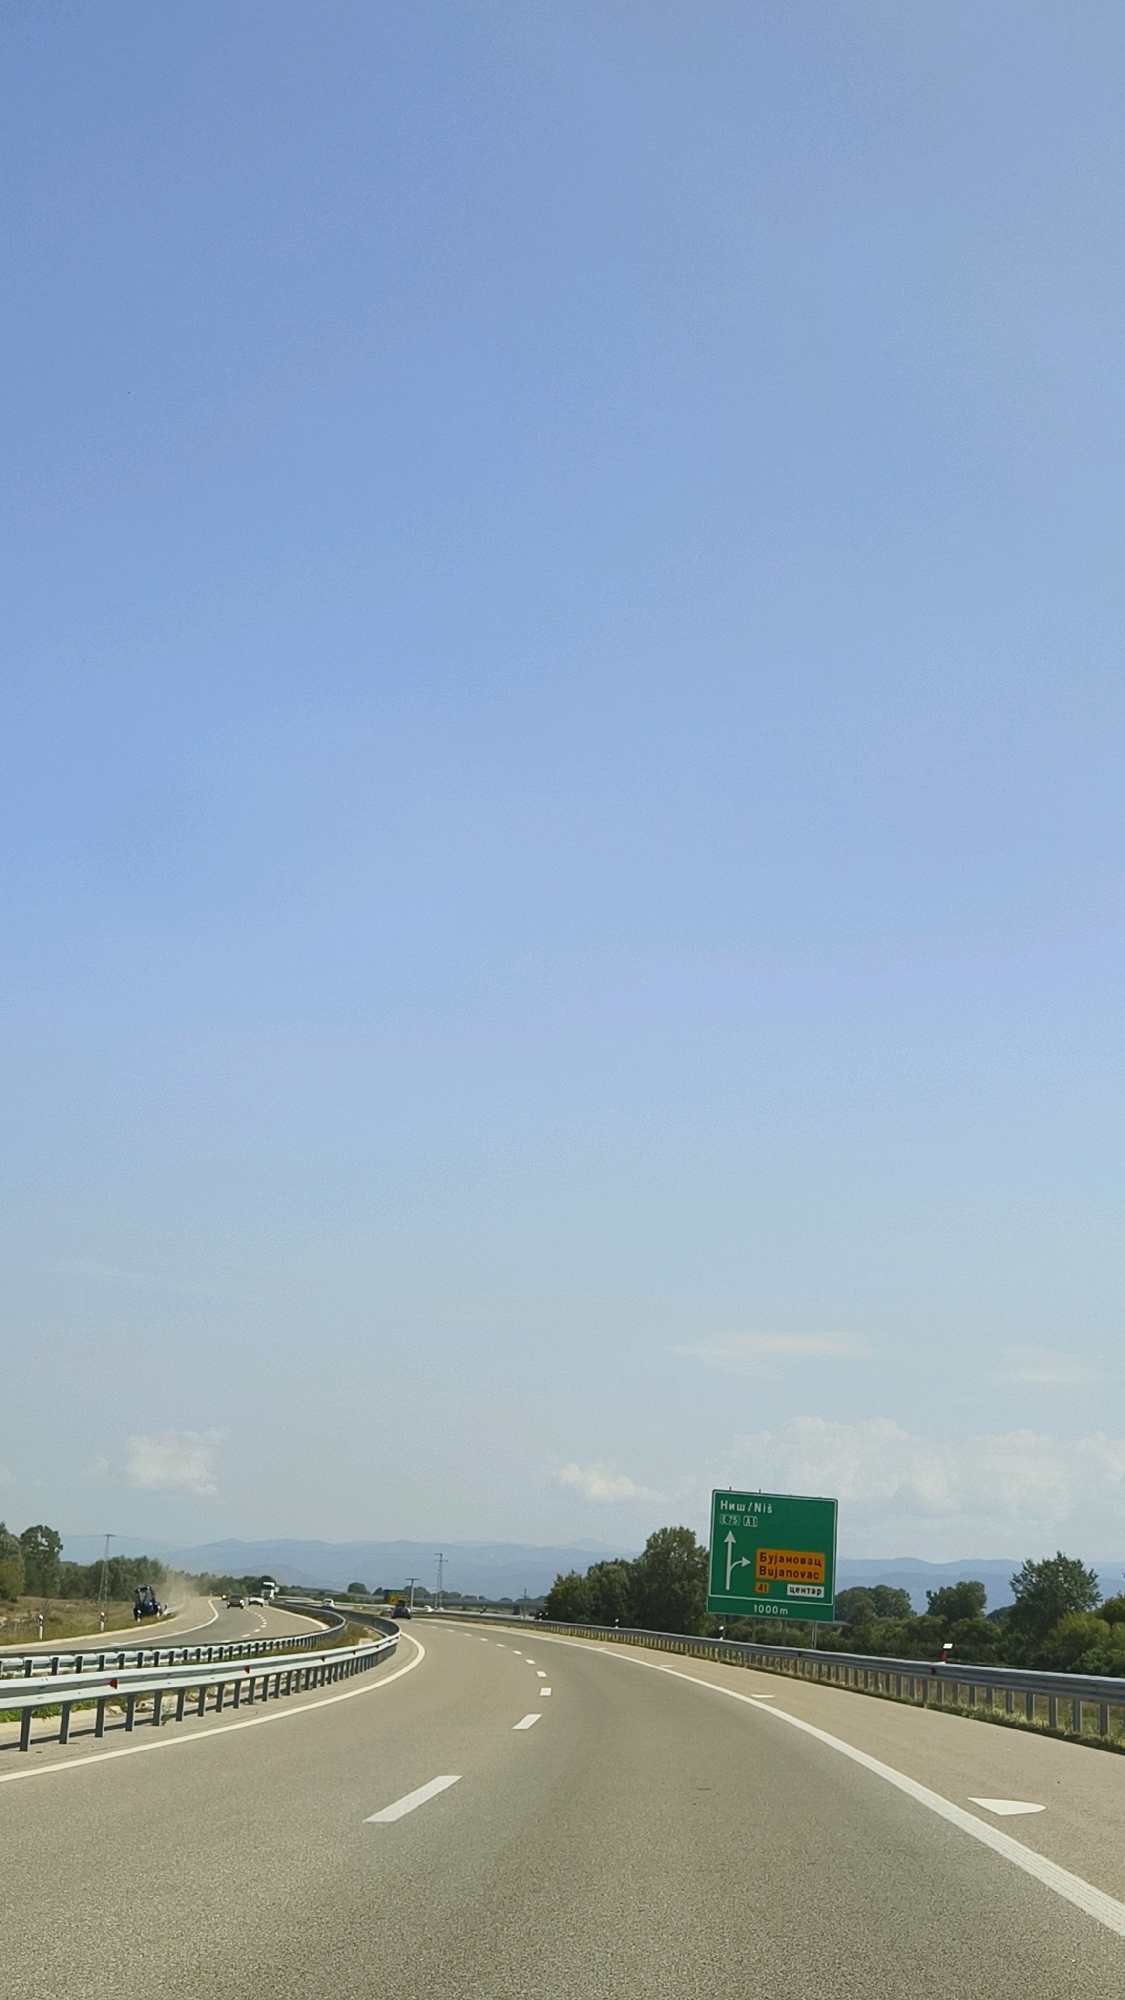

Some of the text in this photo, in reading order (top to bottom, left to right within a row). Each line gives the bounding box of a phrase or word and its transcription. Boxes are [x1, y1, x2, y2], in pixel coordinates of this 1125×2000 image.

[760, 1552, 822, 1567] Бујановац
[759, 1566, 820, 1580] Bujanovac
[758, 1583, 767, 1592] 41
[789, 1586, 822, 1596] центар
